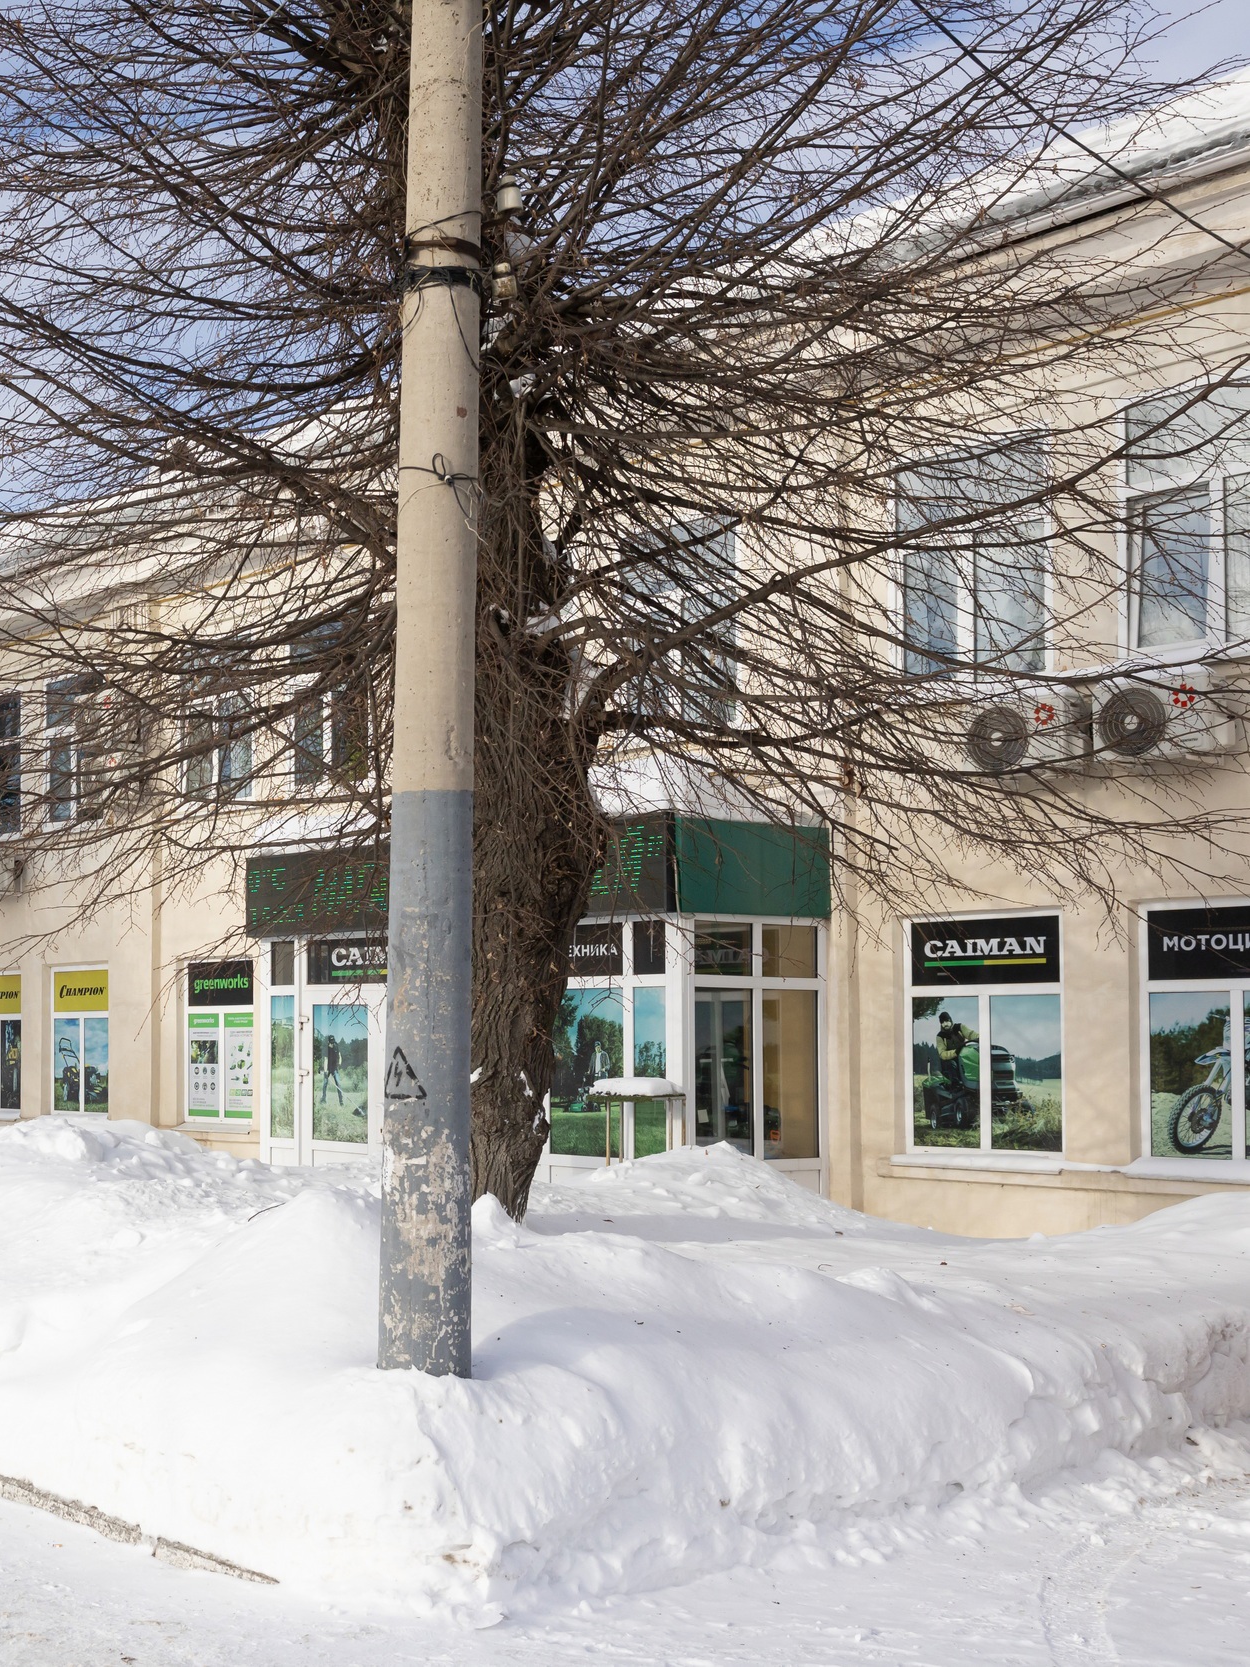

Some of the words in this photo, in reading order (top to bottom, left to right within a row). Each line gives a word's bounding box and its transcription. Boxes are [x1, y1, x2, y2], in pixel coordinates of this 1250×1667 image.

[924, 936, 1046, 958] CAIMAN
[59, 985, 105, 999] CHAMPION
[194, 973, 249, 994] greenworks
